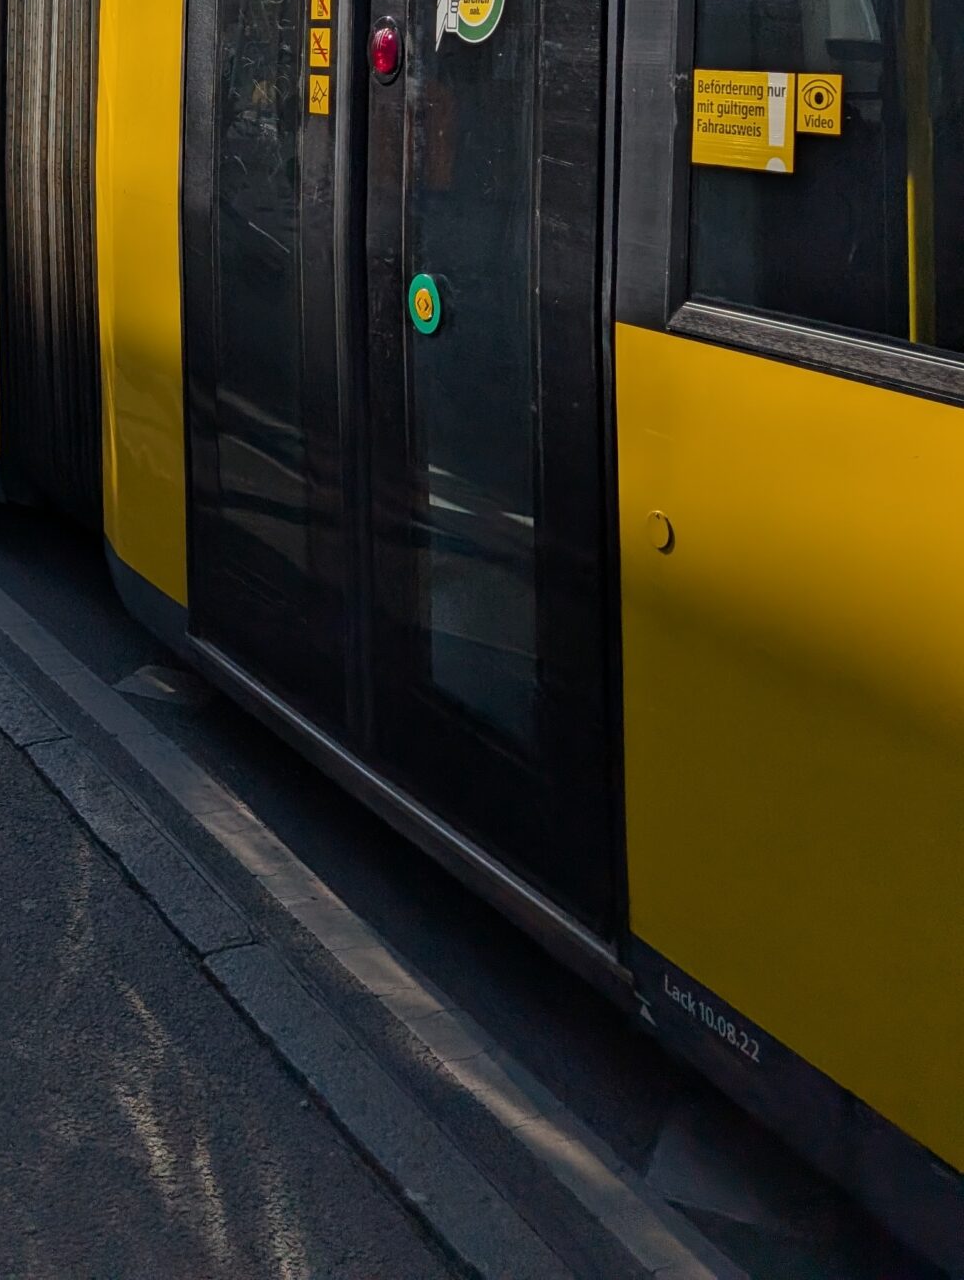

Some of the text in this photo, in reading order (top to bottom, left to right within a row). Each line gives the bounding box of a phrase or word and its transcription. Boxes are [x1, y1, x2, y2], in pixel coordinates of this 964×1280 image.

[469, 6, 480, 16] nah.
[697, 79, 787, 100] Beförderung nur
[696, 99, 765, 120] mit gültigem
[696, 118, 762, 138] Fahrausweis
[804, 114, 834, 129] Video
[664, 974, 761, 1063] Lack 10.08.22
